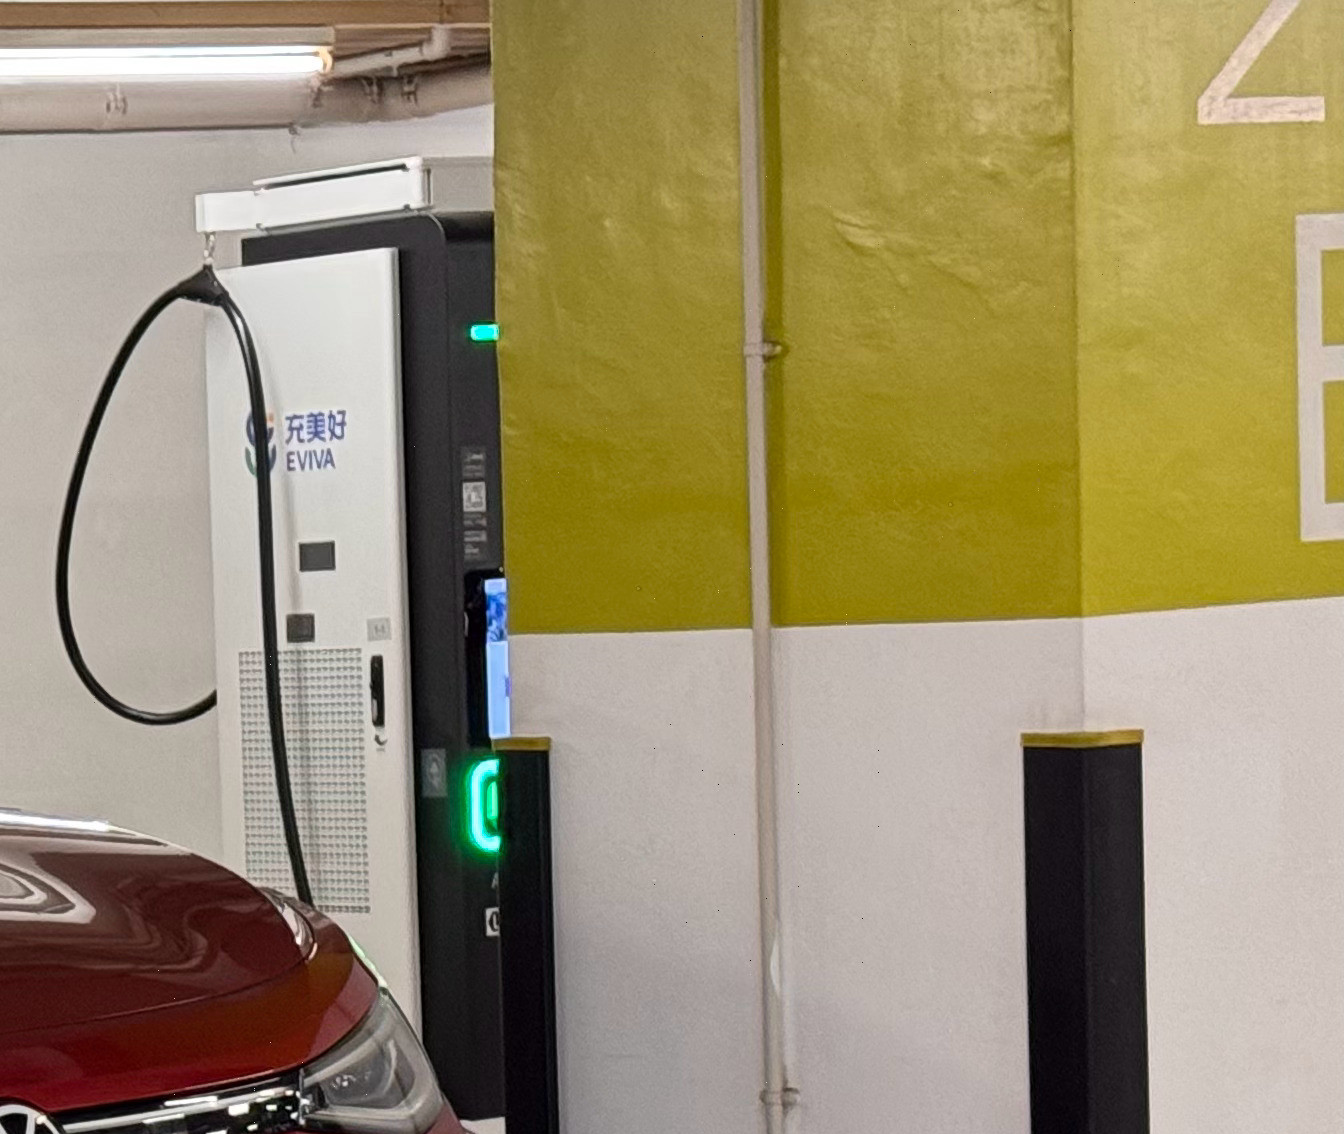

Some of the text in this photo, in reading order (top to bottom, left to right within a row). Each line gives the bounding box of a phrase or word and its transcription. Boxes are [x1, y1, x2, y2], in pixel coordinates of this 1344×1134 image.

[285, 409, 347, 445] 充美好
[286, 447, 336, 472] EVIVA
